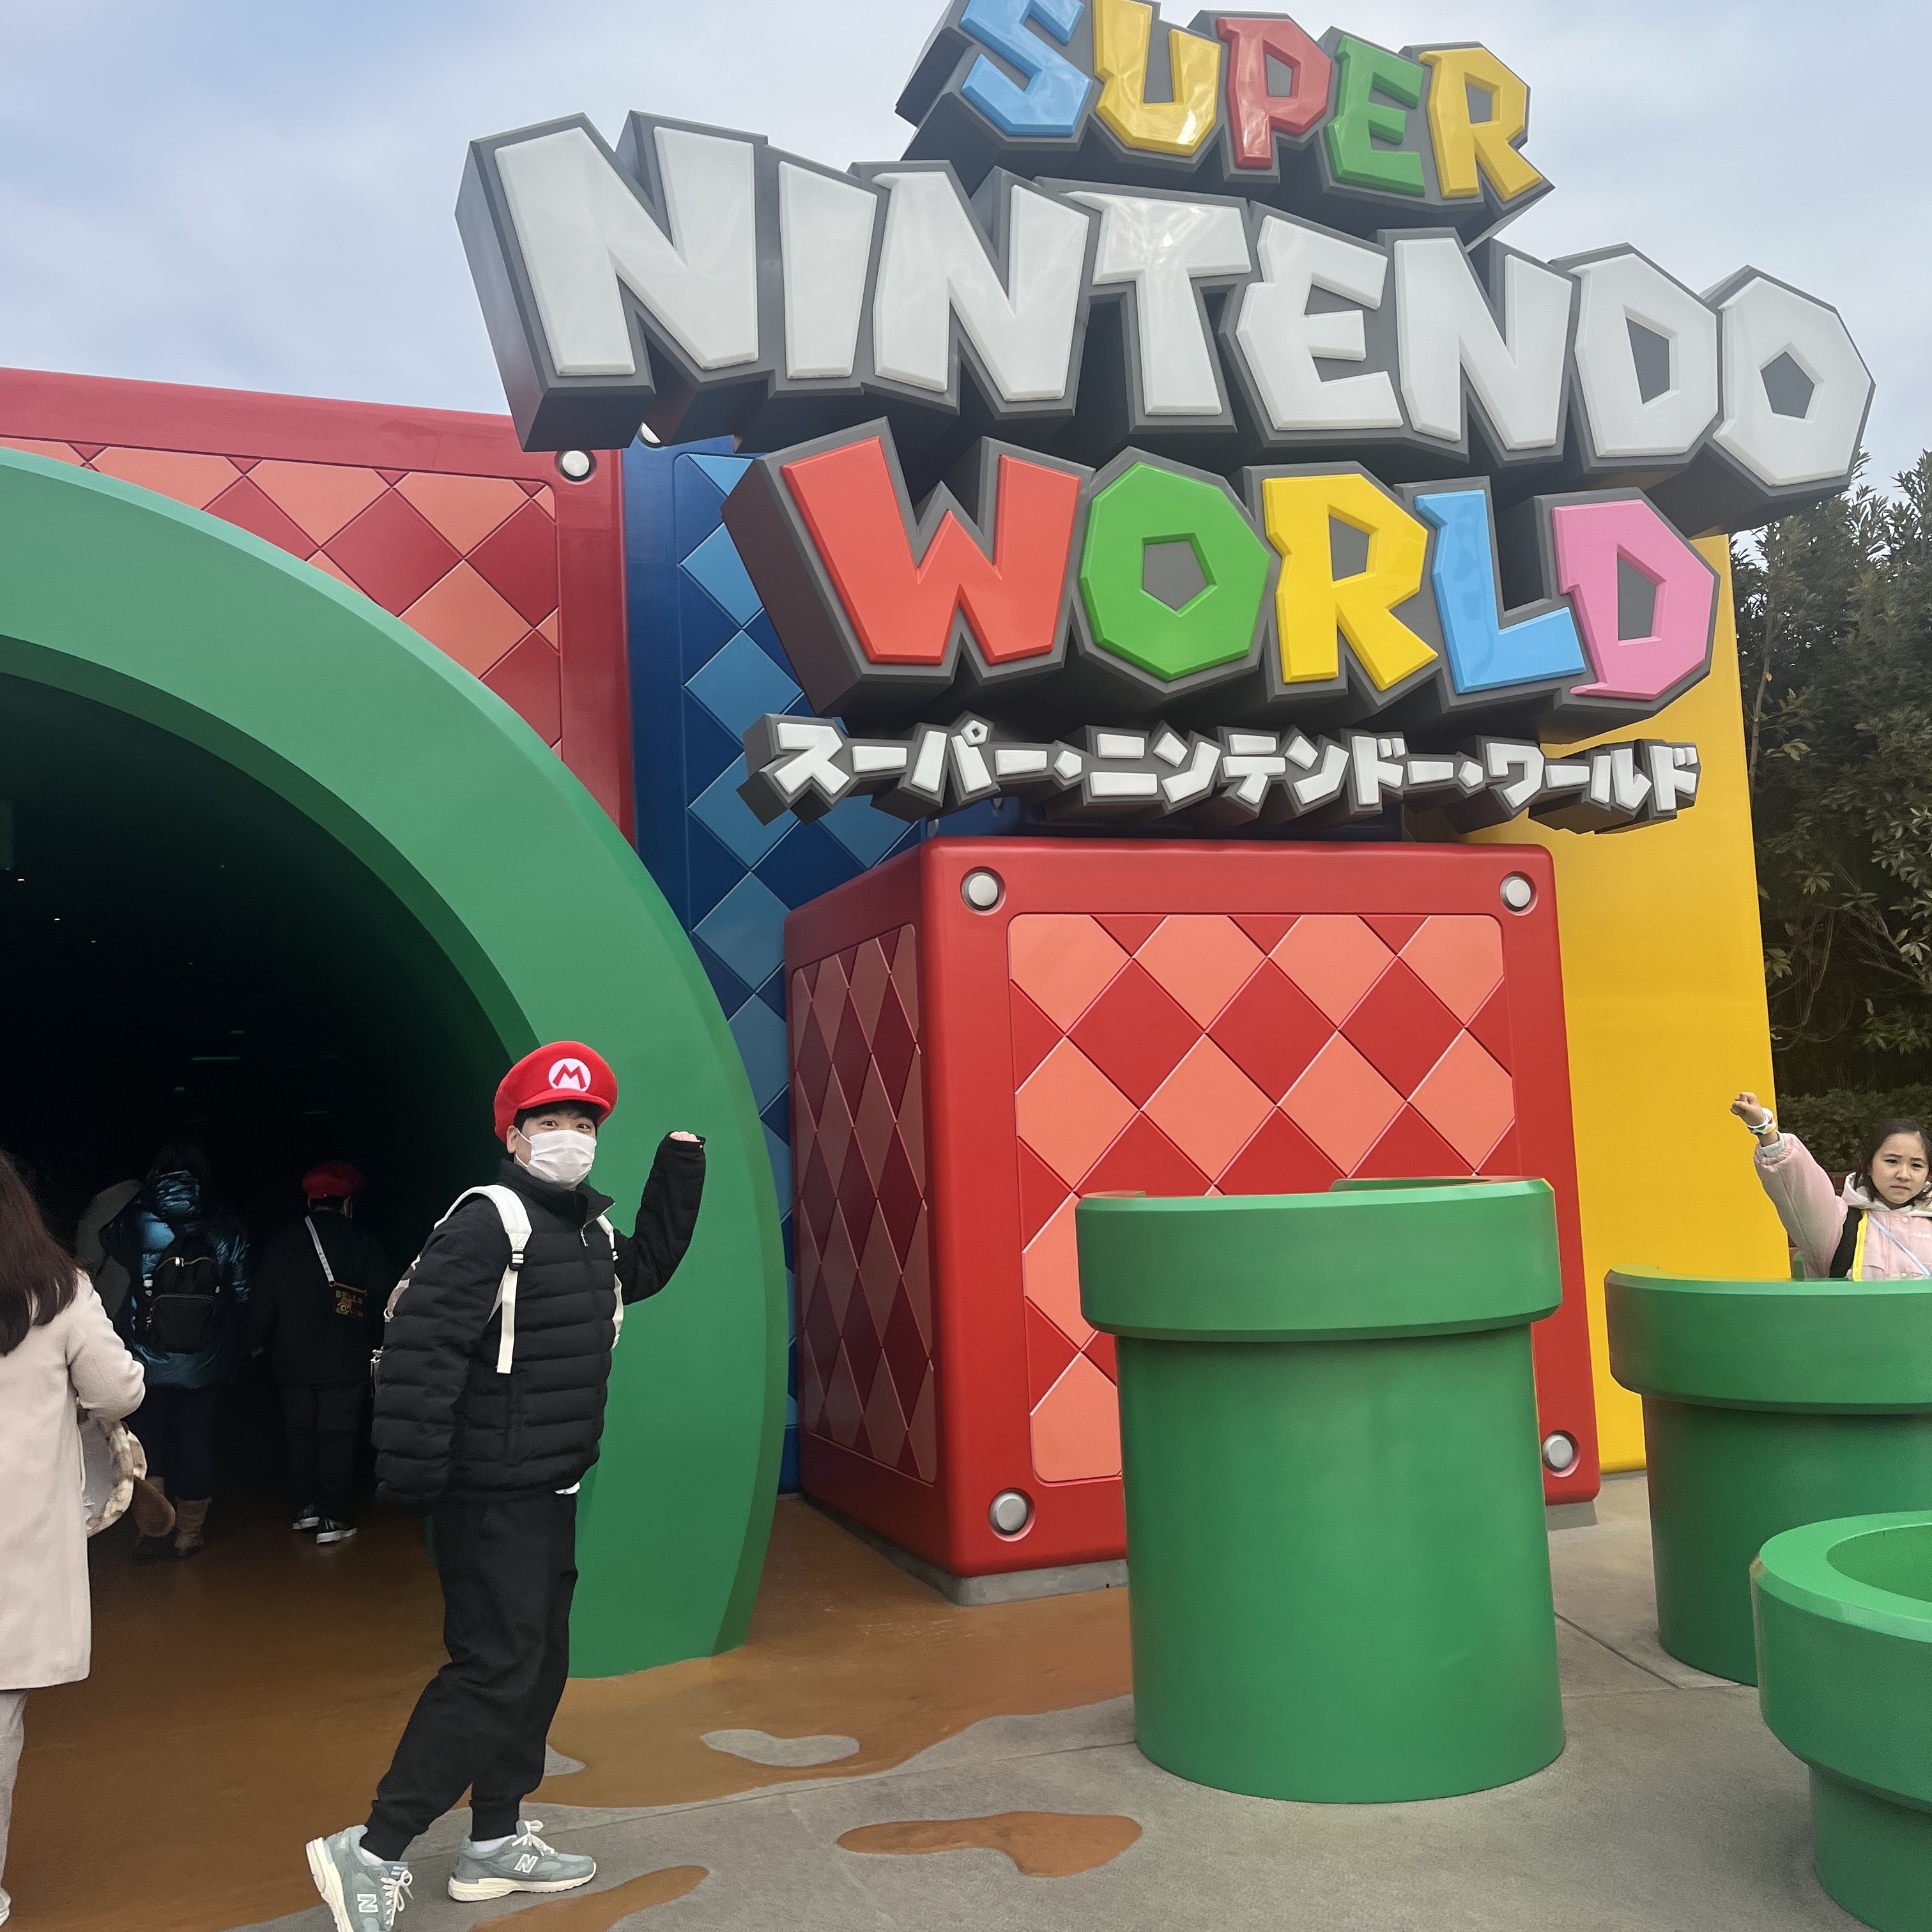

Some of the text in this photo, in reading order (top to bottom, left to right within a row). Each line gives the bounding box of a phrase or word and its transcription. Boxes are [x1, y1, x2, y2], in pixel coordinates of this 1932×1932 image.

[958, 0, 1544, 202] SUPER
[494, 126, 1872, 486] NINTENDO
[779, 436, 1715, 702] WORLD
[774, 719, 1698, 812] スーパー・ニンテンドー・ワールド
[553, 1064, 586, 1089] M
[356, 1893, 378, 1912] N
[514, 1853, 539, 1873] N
